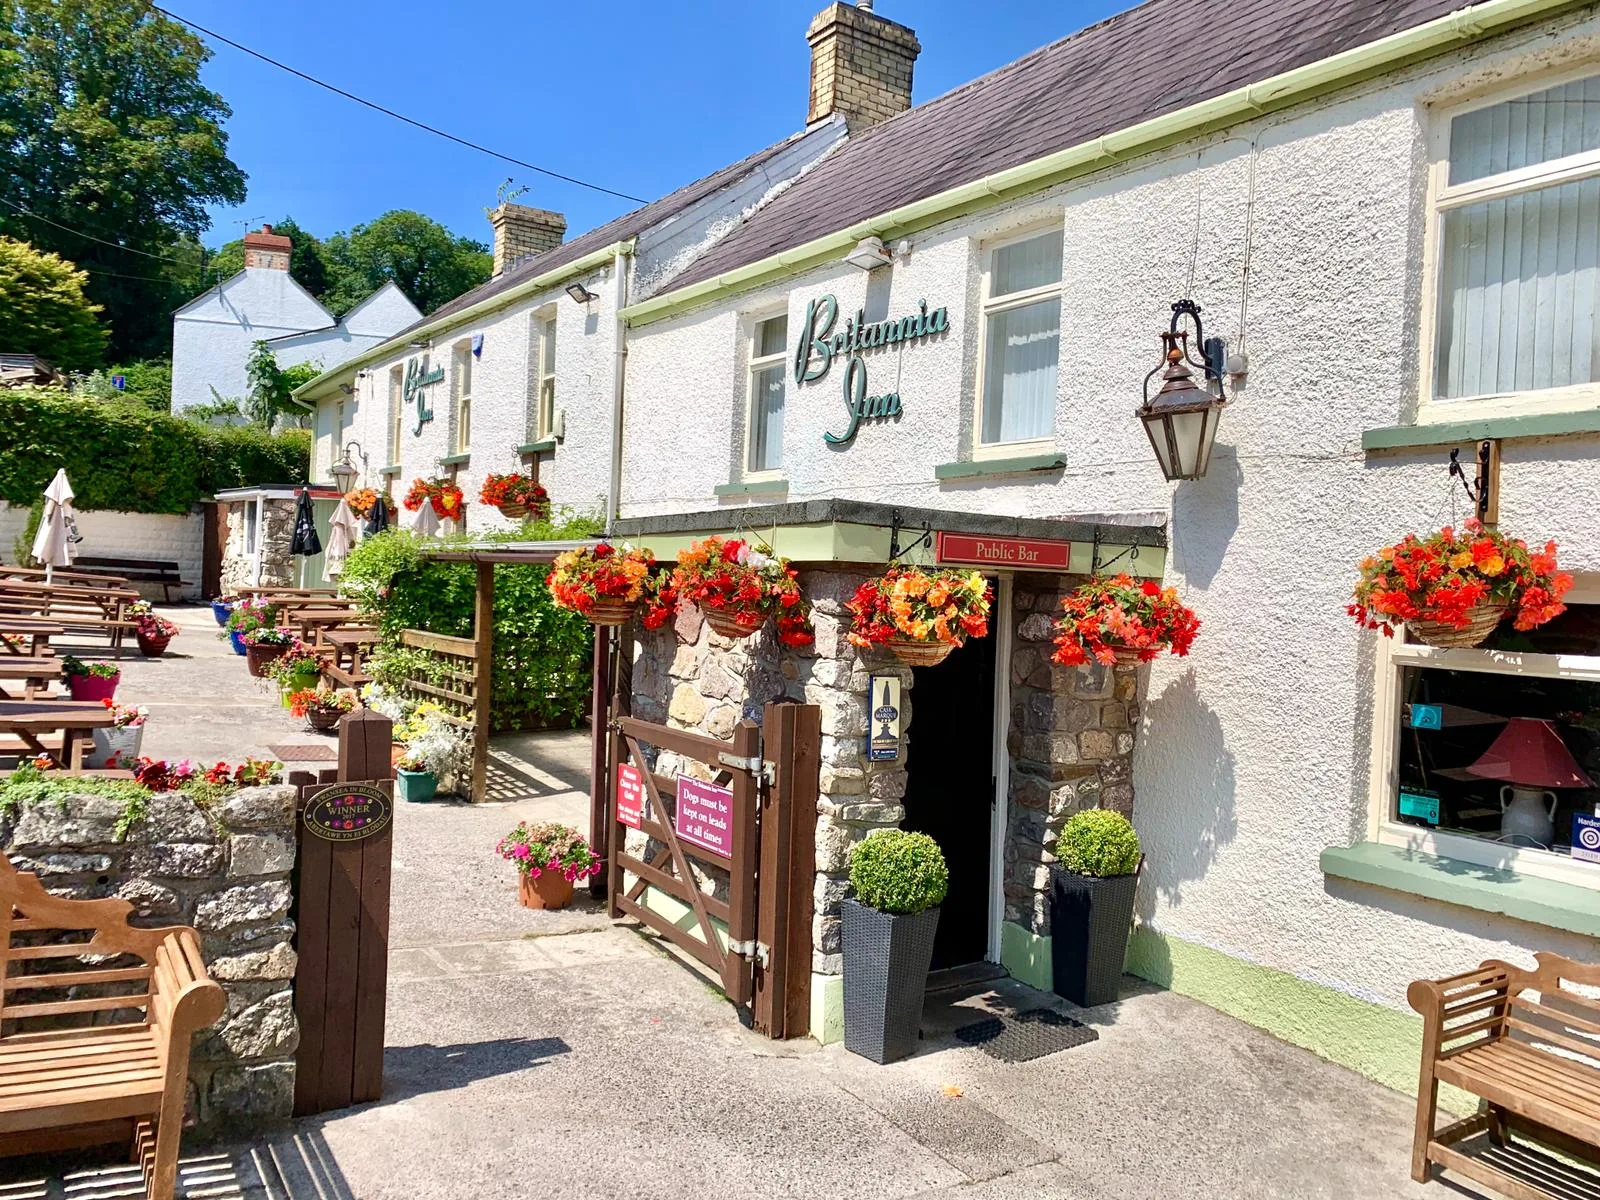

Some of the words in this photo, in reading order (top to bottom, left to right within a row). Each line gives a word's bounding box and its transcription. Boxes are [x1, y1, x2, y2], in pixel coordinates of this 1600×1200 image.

[795, 294, 949, 384] Britannia
[823, 356, 902, 444] Inn
[976, 542, 1015, 560] Public
[1018, 546, 1039, 561] Bar
[315, 787, 348, 804] SWANSEA
[359, 787, 382, 799] BLOOM
[683, 788, 699, 805] Dogs
[700, 797, 718, 810] must
[718, 800, 728, 813] be
[328, 805, 370, 815] WINNER
[683, 803, 698, 820] kept
[698, 812, 708, 823] on
[708, 813, 727, 831] leads
[686, 824, 693, 834] at
[693, 825, 703, 837] all
[703, 828, 722, 845] times
